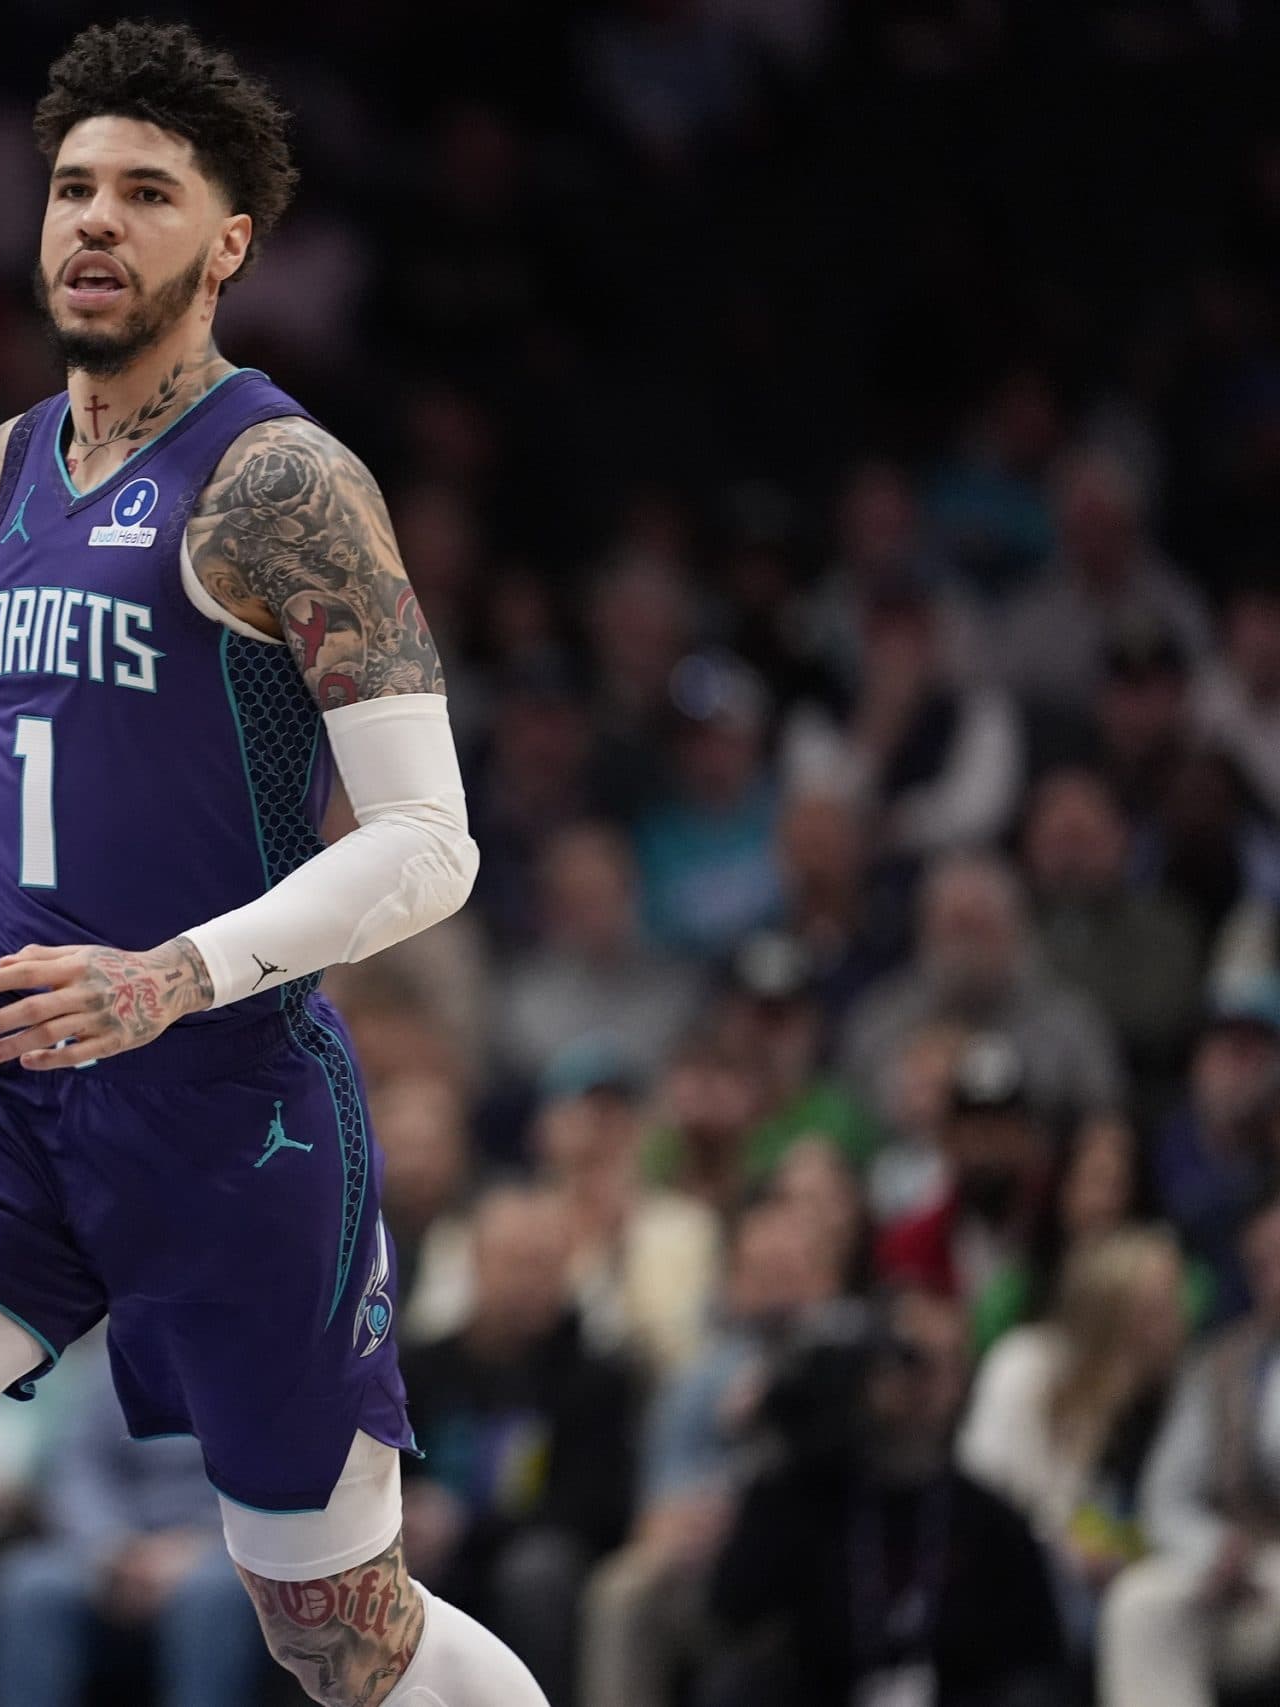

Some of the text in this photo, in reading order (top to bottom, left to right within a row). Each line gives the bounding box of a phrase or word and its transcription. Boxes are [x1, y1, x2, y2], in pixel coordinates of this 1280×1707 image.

[91, 529, 153, 545] Judi Health
[13, 714, 58, 889] 1
